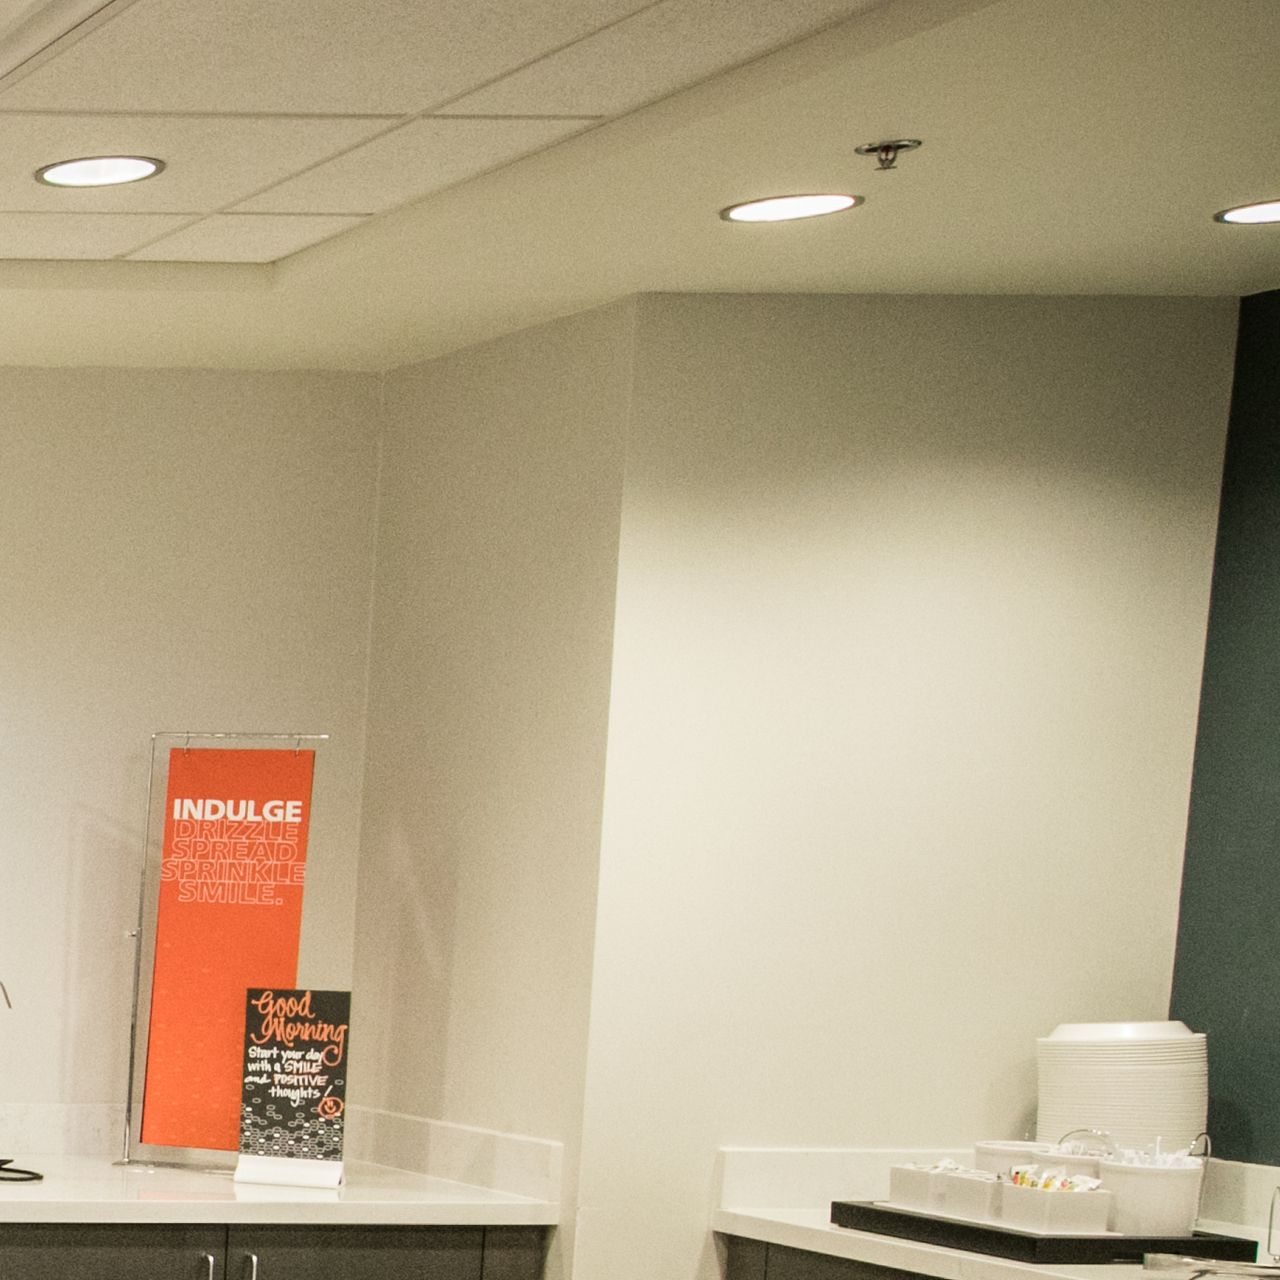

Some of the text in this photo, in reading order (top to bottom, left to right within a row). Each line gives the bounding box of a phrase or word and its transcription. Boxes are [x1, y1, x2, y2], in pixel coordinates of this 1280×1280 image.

[173, 798, 303, 822] INDULGE
[174, 819, 300, 843] DRIZZLE
[171, 839, 298, 864] SPREAD
[161, 858, 306, 885] SPRINKLE
[178, 880, 284, 905] SMILE.
[272, 1018, 348, 1066] Morning
[247, 1059, 322, 1074] with a SMILE
[248, 1046, 324, 1064] Start your day
[244, 1074, 329, 1087] and POSITIVE
